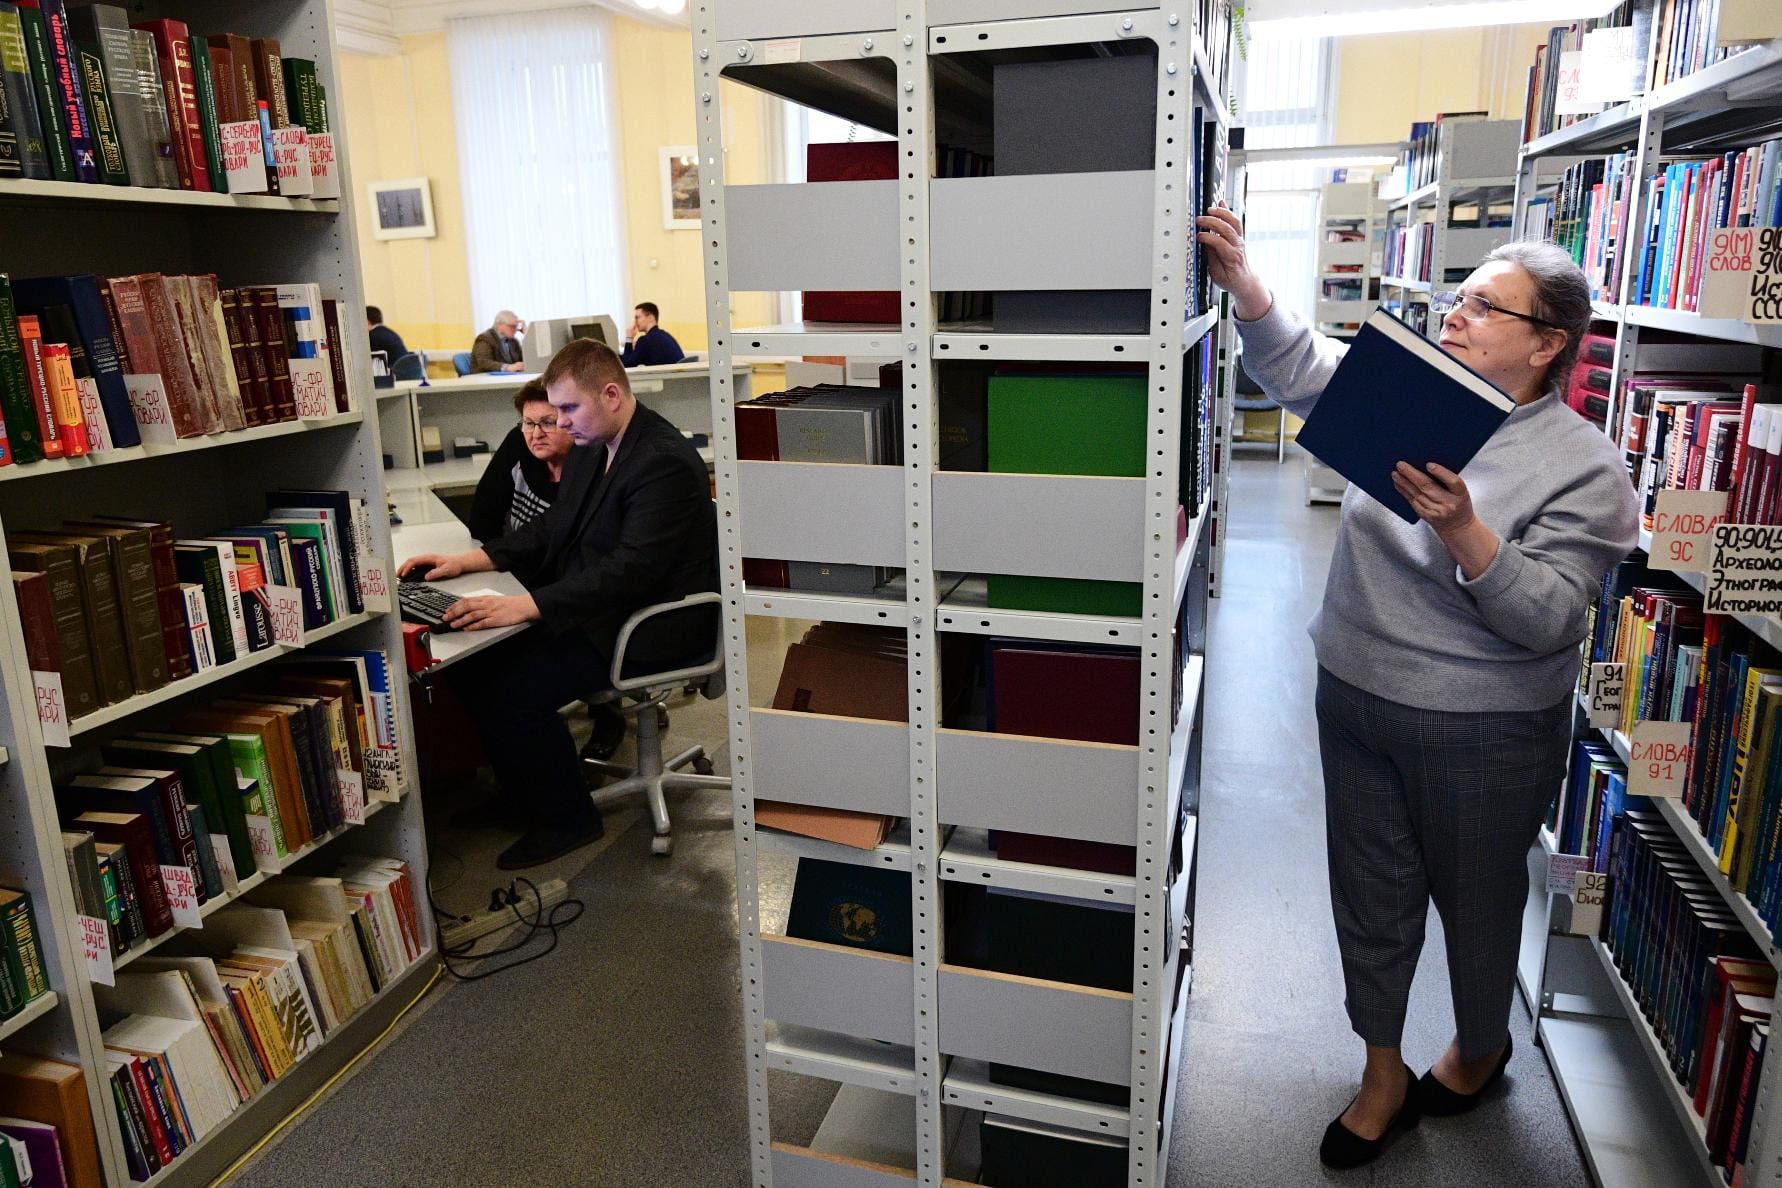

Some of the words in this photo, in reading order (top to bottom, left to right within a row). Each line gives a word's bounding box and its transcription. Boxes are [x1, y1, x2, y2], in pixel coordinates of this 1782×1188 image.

[51, 13, 66, 56] словарь
[56, 58, 77, 105] учебный
[66, 105, 82, 139] Новый
[1709, 256, 1753, 272] СЛОВ
[32, 339, 41, 361] НОВЫЙ
[46, 414, 57, 441] СЛОВАРЬ
[231, 595, 242, 621] Lingvo
[252, 602, 270, 649] Larousse
[1603, 664, 1624, 682] 91
[1740, 681, 1755, 748] ГЕОГРАФИЧЕСКИЙ
[1648, 763, 1674, 780] 91
